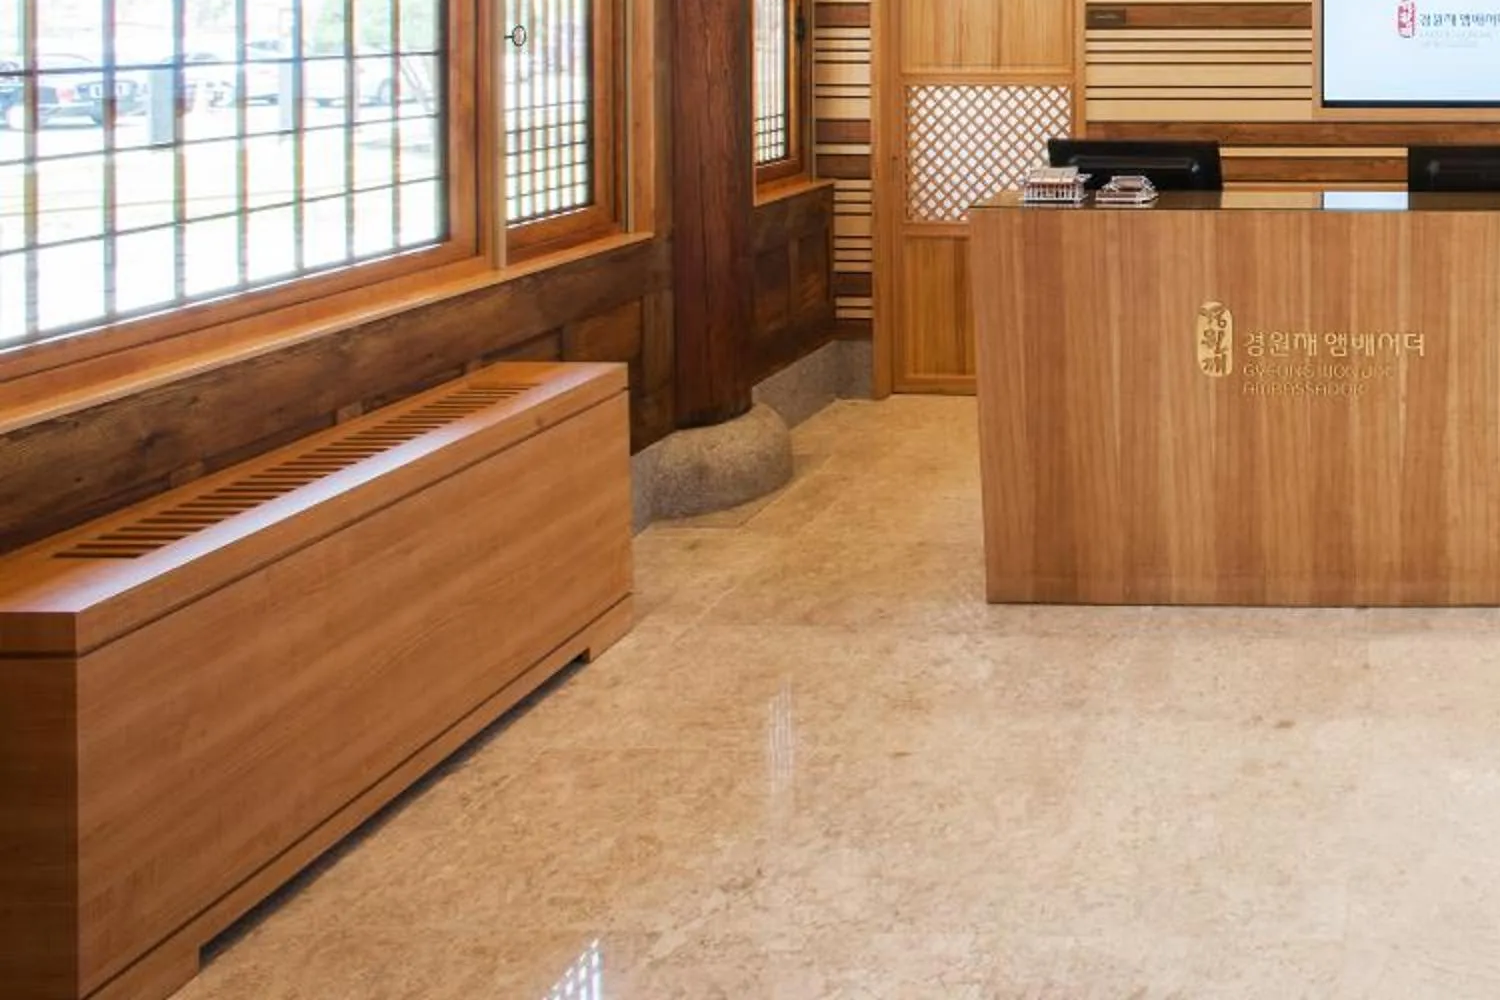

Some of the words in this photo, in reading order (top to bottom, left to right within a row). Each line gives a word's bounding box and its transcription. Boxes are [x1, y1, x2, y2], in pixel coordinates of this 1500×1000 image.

[1243, 330, 1318, 357] 경원재
[1324, 330, 1425, 357] 앰배서더
[1242, 381, 1370, 396] AMBASSADOR
